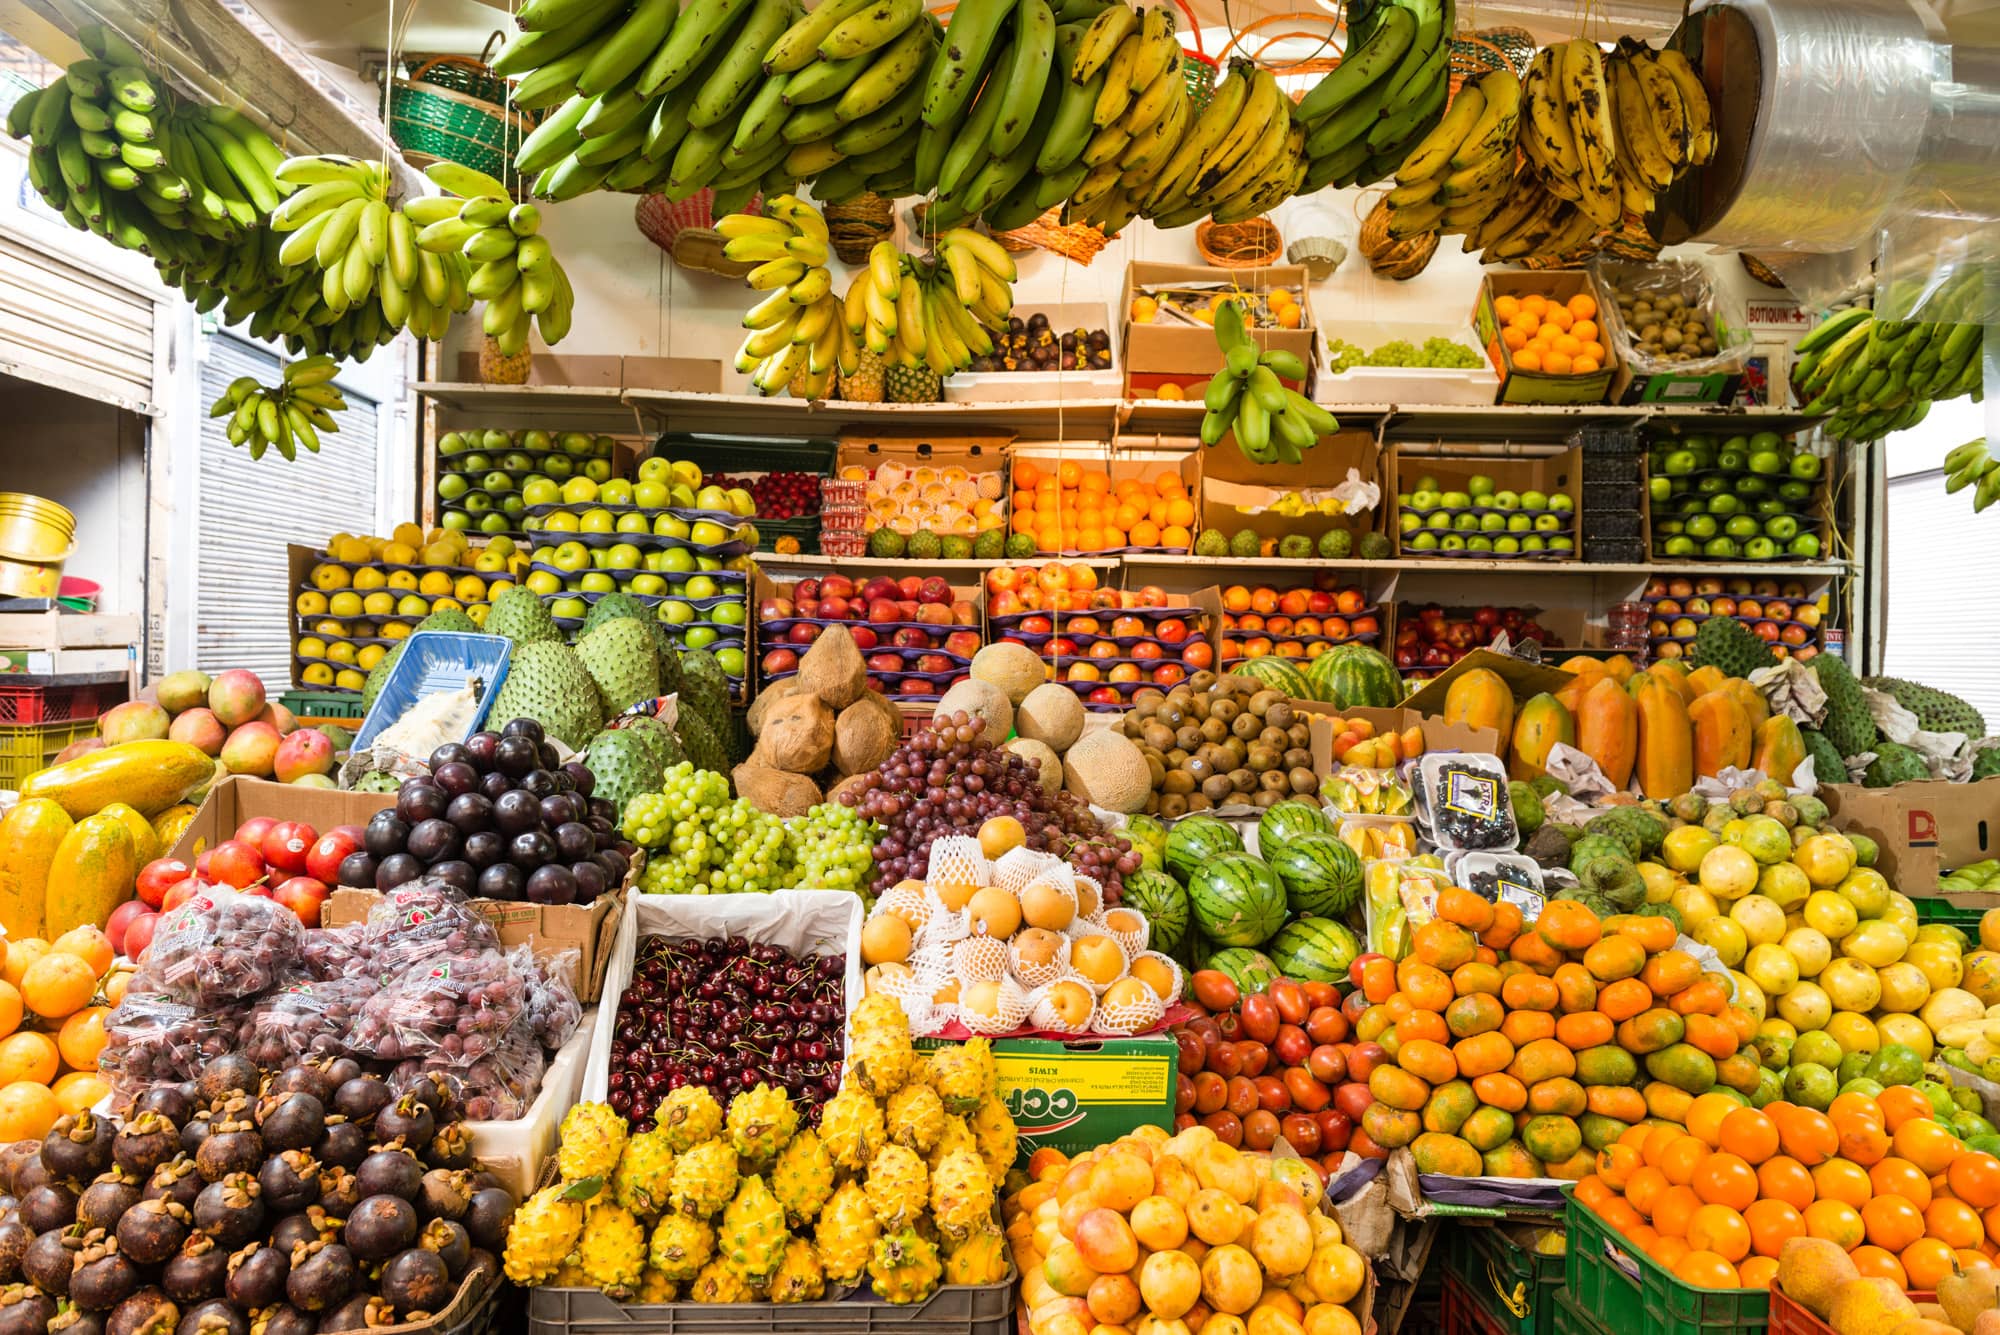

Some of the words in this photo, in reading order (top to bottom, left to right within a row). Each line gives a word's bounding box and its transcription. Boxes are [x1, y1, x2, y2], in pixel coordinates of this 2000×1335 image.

[1749, 307, 1788, 323] BOTIQUIN
[1478, 783, 1491, 812] EXTRA
[1028, 1067, 1058, 1075] KIWIS
